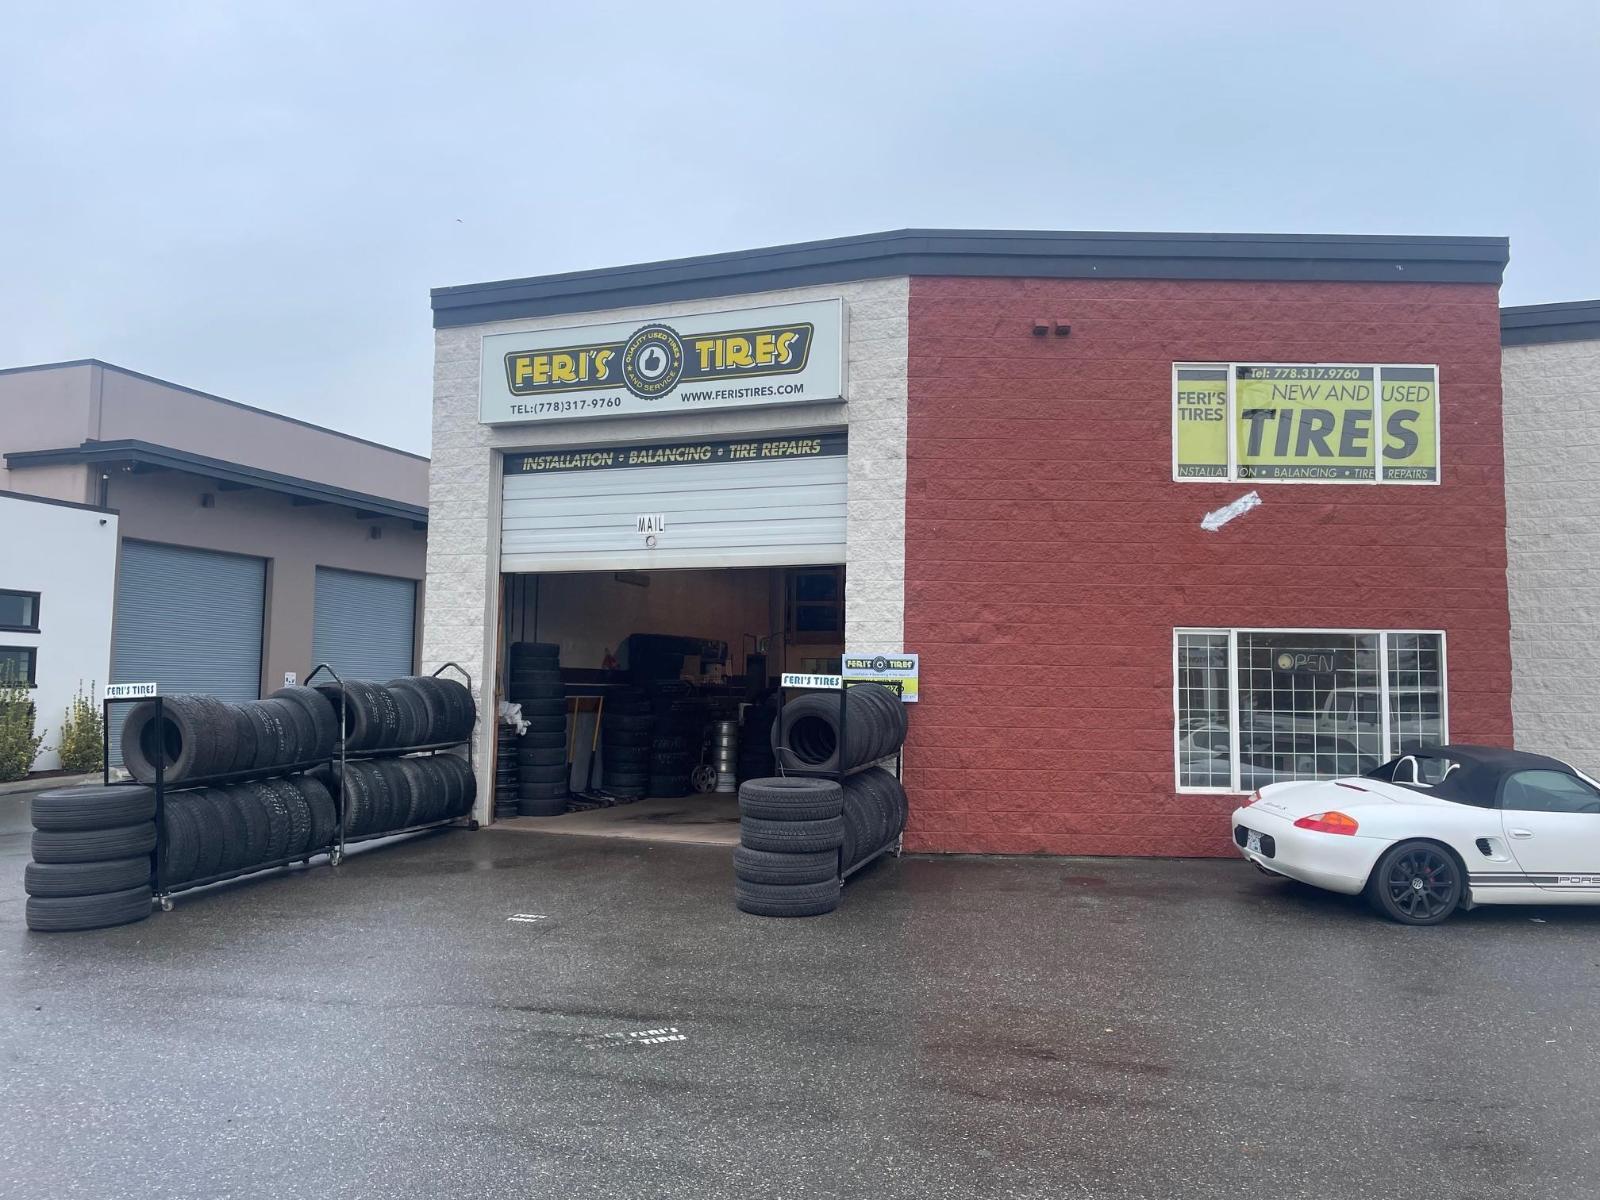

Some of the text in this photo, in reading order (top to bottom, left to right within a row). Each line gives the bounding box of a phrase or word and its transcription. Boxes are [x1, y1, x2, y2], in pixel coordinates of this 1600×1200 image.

[625, 332, 680, 363] QUALITY USED TIRES
[515, 332, 800, 387] FERI'S TIRES
[629, 370, 676, 391] AND SERVICE
[1250, 368, 1360, 380] Tel: 778.317.9760
[680, 383, 804, 402] WWW.FERISTIRES.COM
[1177, 391, 1226, 405] FERI'S
[1271, 384, 1430, 402] NEW AND USED
[1178, 407, 1224, 421] TIRES
[1242, 408, 1420, 460] TIRES
[522, 439, 821, 471] INSTALLATION BALANCING TIRE REPAIRS
[1179, 466, 1428, 480] NSTALLATION BALANCING TIRE REPAIRS
[638, 516, 664, 532] MAIL
[1277, 653, 1334, 673] OPEN
[132, 684, 154, 695] TIRES
[783, 675, 840, 686] FERI'S TIRES
